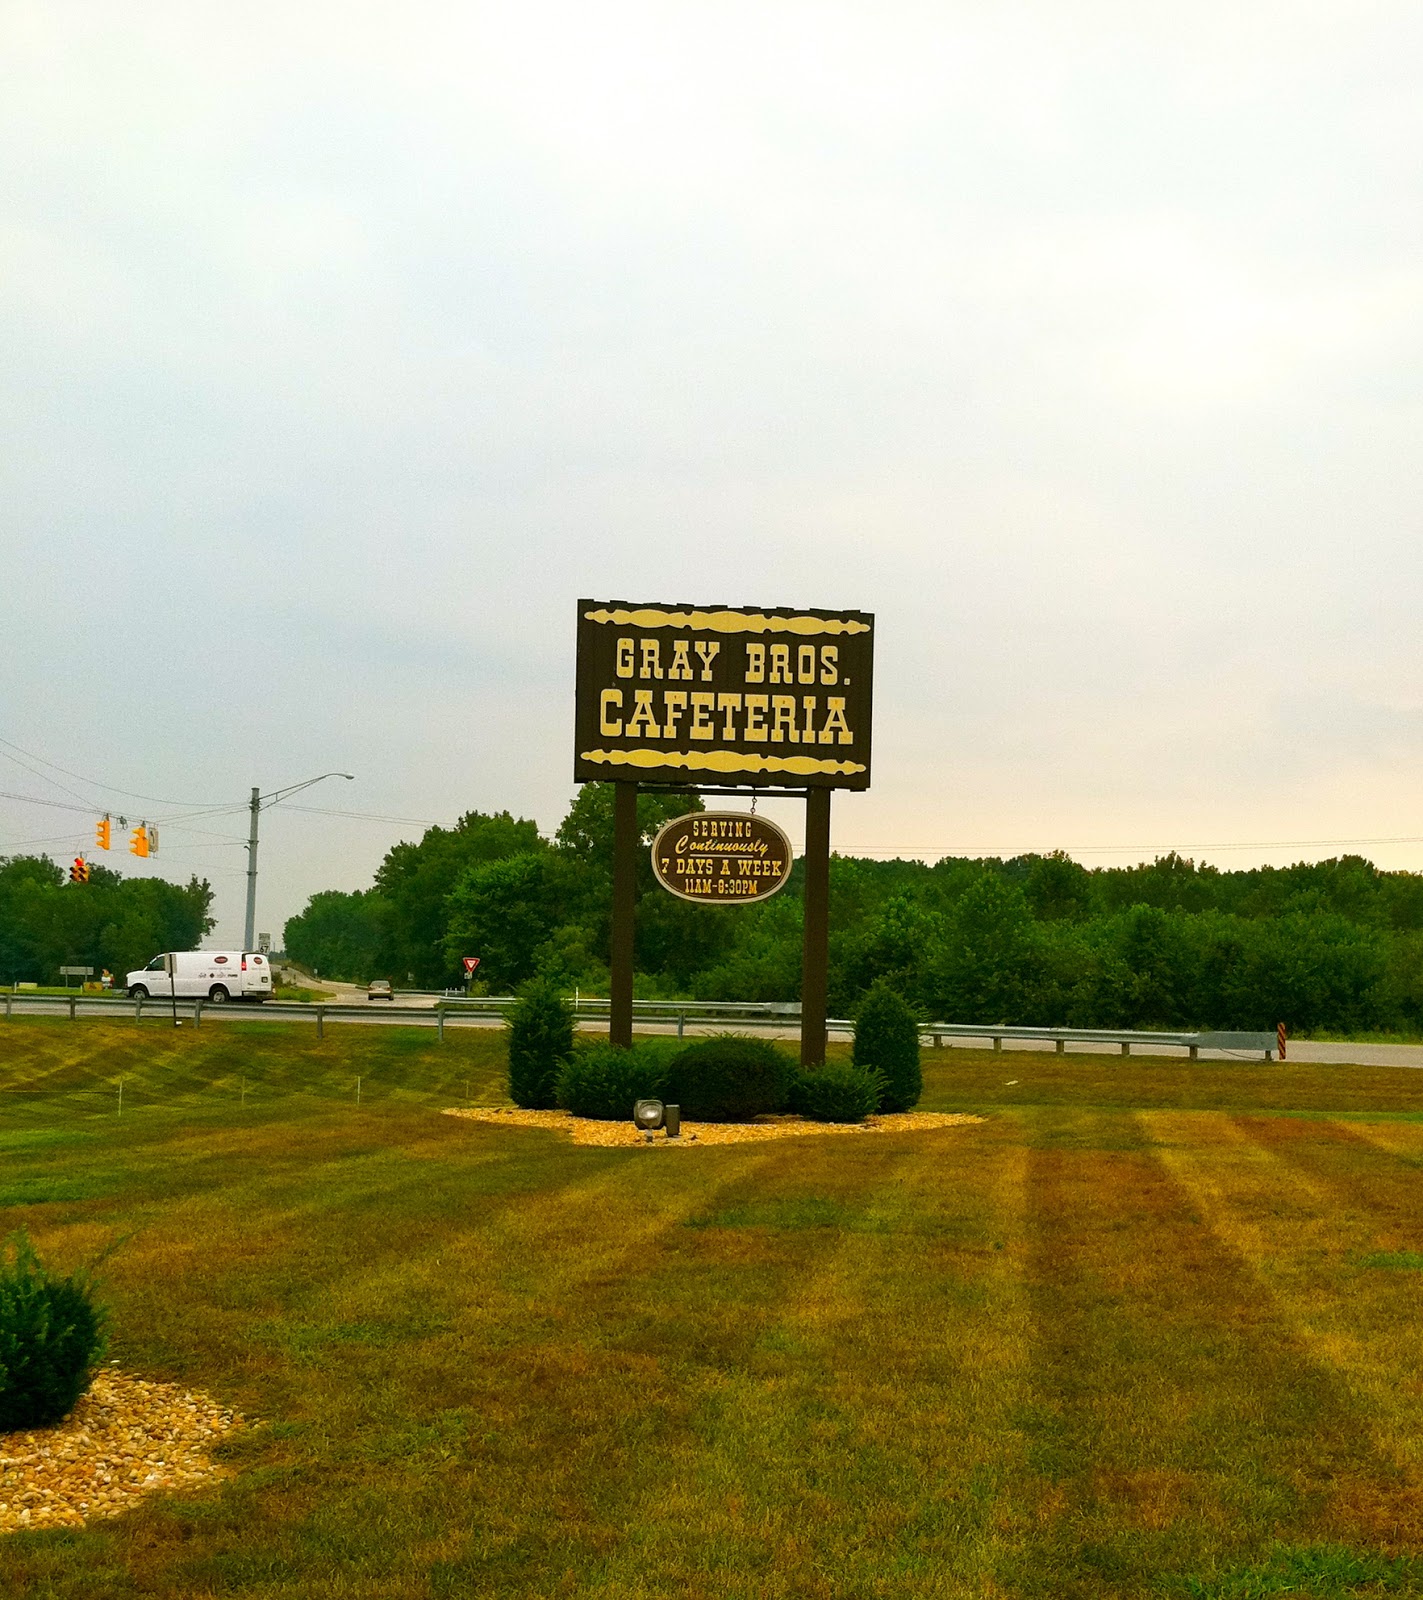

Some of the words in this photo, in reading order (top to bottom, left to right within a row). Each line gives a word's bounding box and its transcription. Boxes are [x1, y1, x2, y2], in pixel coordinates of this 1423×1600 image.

[616, 637, 720, 682] GRAY
[745, 643, 851, 686] BROS.
[600, 688, 854, 745] CAFETERIA
[693, 821, 752, 838] SERVING
[675, 835, 769, 858] Continuously
[661, 858, 670, 874] 7
[676, 858, 714, 875] DAYS
[720, 859, 731, 876] A
[738, 860, 782, 876] WEEK
[685, 878, 758, 895] 11AM-8:30PM
